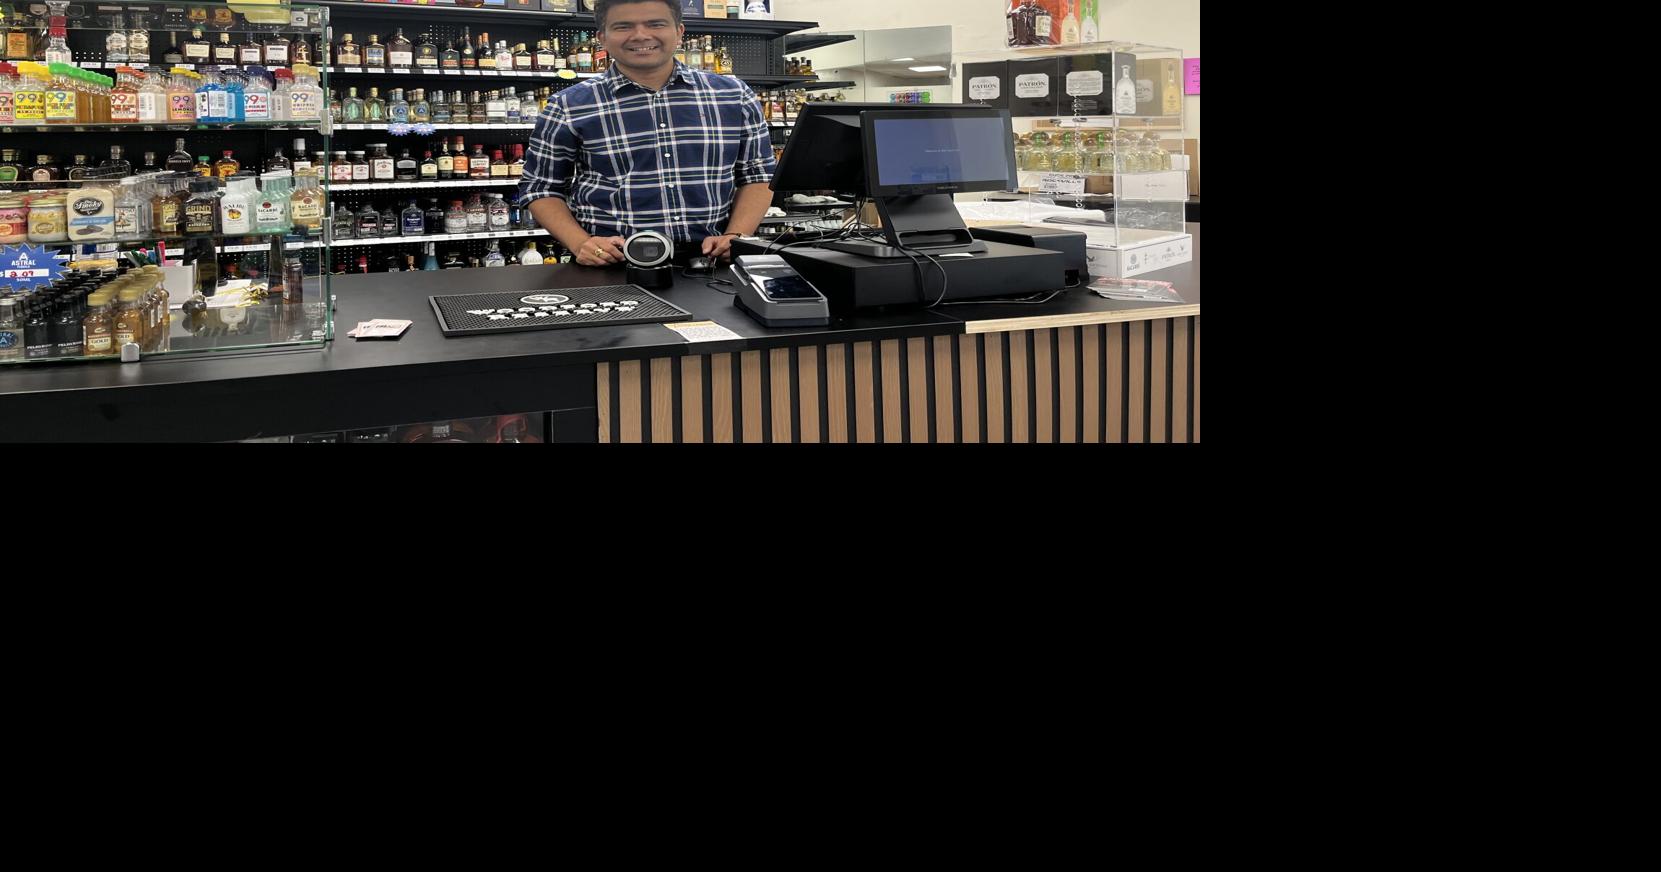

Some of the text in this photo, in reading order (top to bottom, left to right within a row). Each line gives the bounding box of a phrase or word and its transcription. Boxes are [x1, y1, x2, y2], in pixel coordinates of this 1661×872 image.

[17, 93, 37, 103] 99
[111, 94, 128, 104] 99
[172, 95, 190, 104] 99
[291, 92, 309, 102] 99
